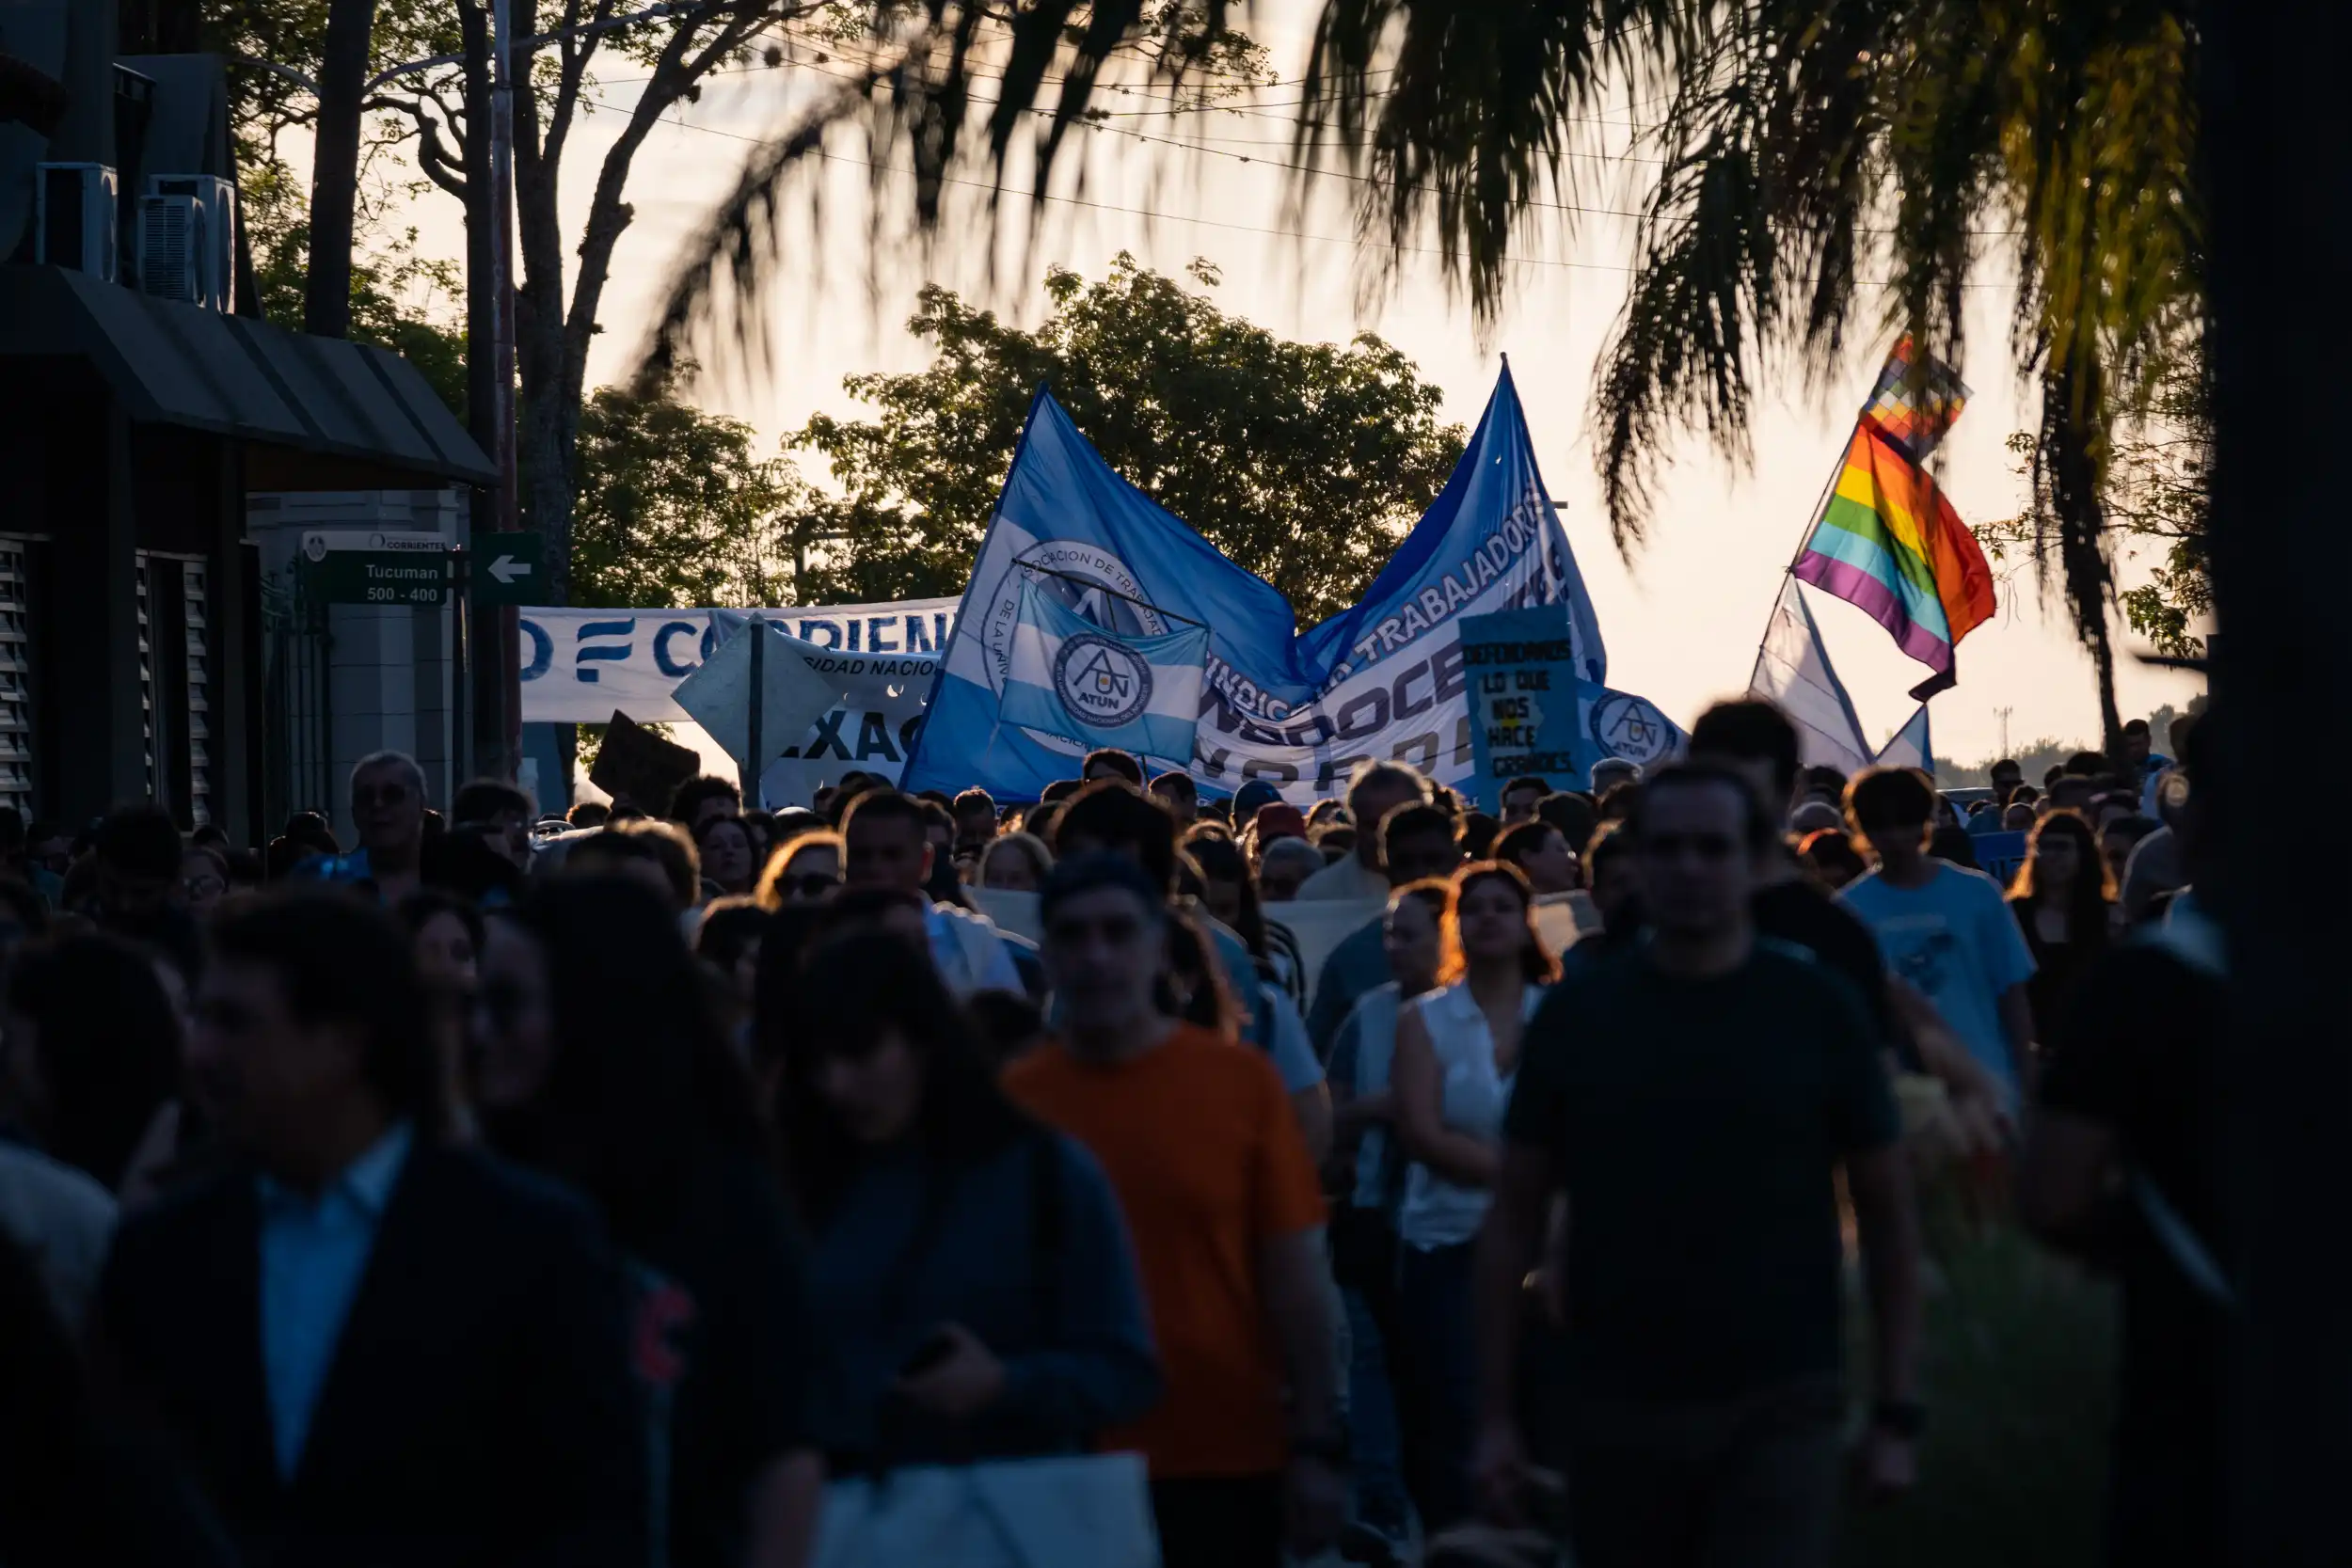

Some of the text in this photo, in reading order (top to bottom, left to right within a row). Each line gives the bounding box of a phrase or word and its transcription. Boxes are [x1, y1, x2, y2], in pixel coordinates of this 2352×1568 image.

[387, 541, 446, 550] CORRIENTES
[365, 564, 438, 579] Tucuman
[1094, 558, 1115, 576] DE
[367, 587, 395, 601] 500
[409, 587, 438, 602] 400
[999, 599, 1015, 620] DE
[1484, 669, 1551, 693] LO QUE
[1078, 691, 1120, 709] ATUN
[1492, 697, 1530, 719] NOS
[1487, 726, 1537, 747] HACE
